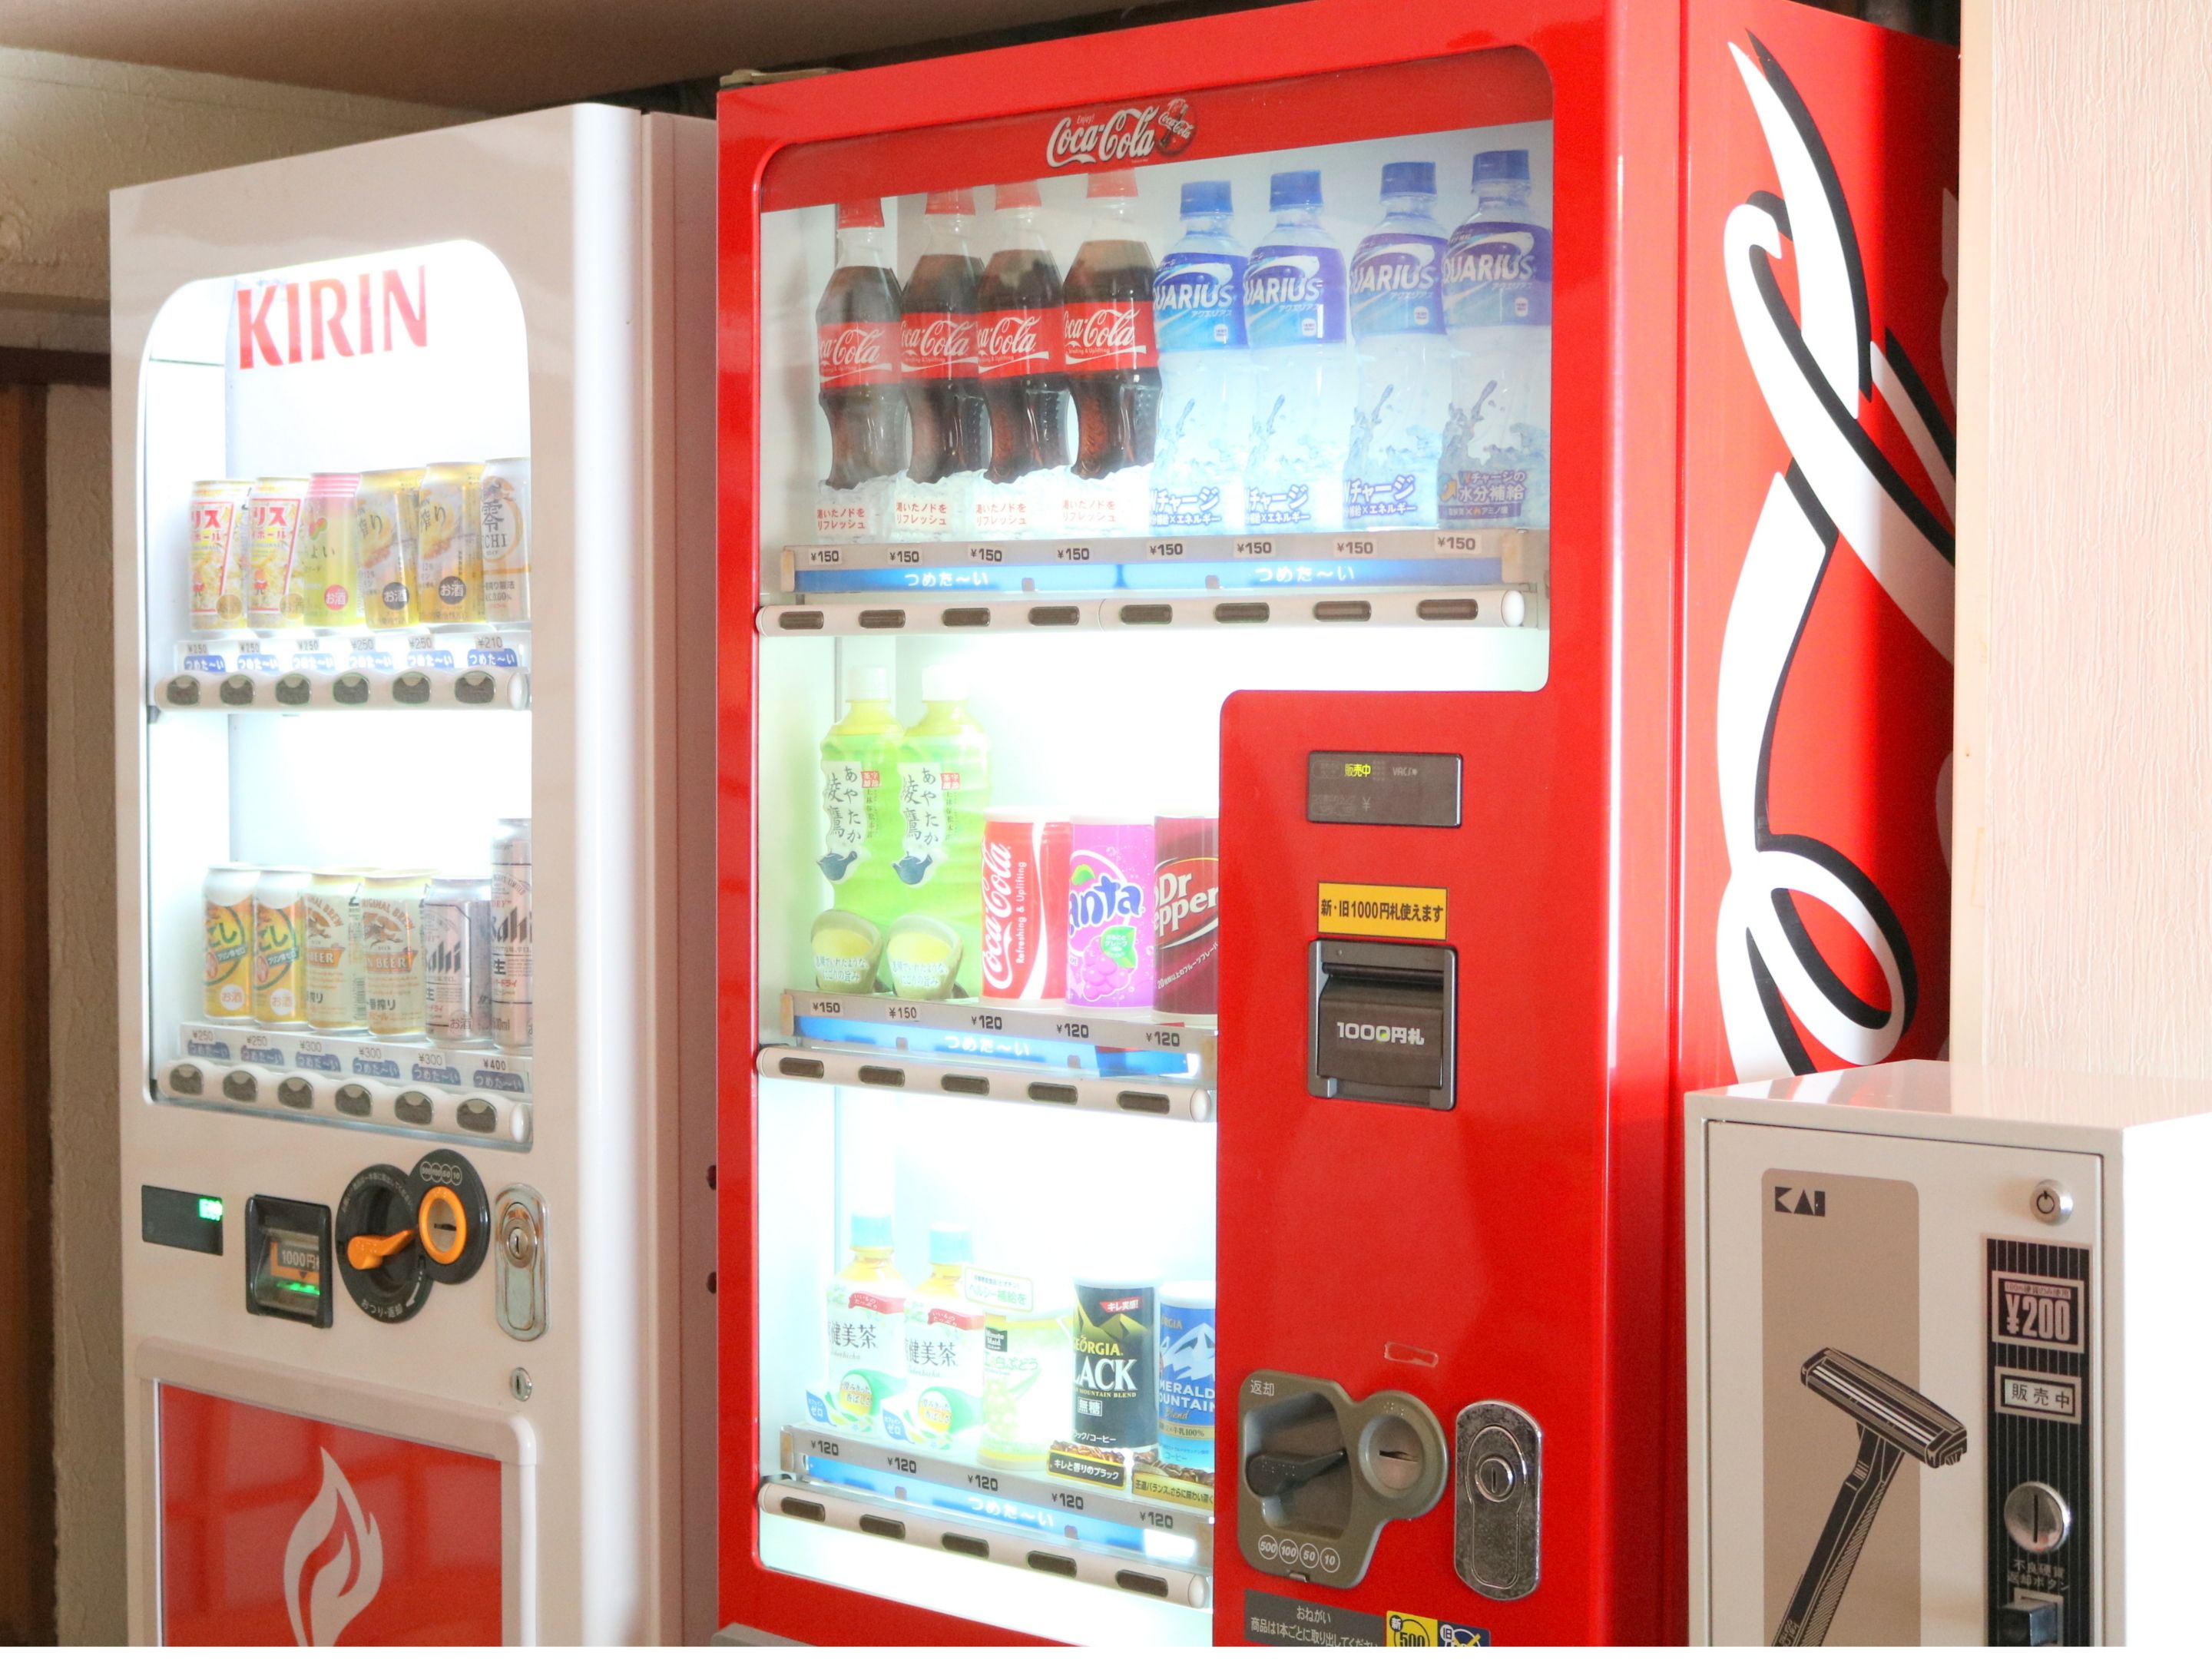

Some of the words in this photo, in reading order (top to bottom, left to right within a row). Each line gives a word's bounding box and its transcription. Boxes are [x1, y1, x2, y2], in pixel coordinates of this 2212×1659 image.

[1046, 105, 1161, 168] Coca-Cola
[237, 265, 428, 370] KIRIN
[1459, 484, 1525, 502] 水分補給
[817, 519, 865, 530] リフレッシュ
[896, 514, 946, 526] リフレッシュ
[976, 514, 1027, 526] リフレッシュ
[1063, 512, 1117, 523] リフレッシュ
[1150, 542, 1184, 556] ¥150
[1237, 541, 1272, 555] ¥150
[1337, 541, 1373, 555] ¥150
[1438, 535, 1476, 551] ¥150
[810, 549, 839, 562] ¥150
[889, 550, 919, 563] ¥150
[971, 548, 1002, 562] ¥150
[1058, 547, 1090, 561] ¥150
[905, 571, 989, 588] つめた～い
[1254, 565, 1355, 582] つめた～い
[325, 590, 346, 605] お酒
[384, 589, 407, 603] お酒
[440, 584, 464, 598] お酒
[187, 643, 207, 654] ¥250
[240, 641, 260, 653] ¥250
[298, 639, 320, 651] ¥250
[351, 638, 374, 651] ¥250
[409, 636, 432, 649] ¥250
[477, 636, 504, 648] ¥210
[469, 653, 516, 666] つめた～い
[844, 765, 862, 845] あやたか
[921, 767, 939, 846] あやたか
[1015, 861, 1028, 902] Uplifting
[1159, 872, 1193, 906] Dr
[1321, 898, 1444, 923] 新・旧1000円札使えます
[1016, 916, 1028, 964] Refreshing
[813, 1001, 840, 1015] ¥150
[889, 1005, 919, 1020] ¥150
[971, 1015, 1003, 1031] ¥120
[1056, 1022, 1090, 1038] ¥120
[193, 1030, 214, 1041] ¥250
[247, 1035, 267, 1047] ¥250
[1145, 1031, 1181, 1047] ¥120
[1336, 1022, 1426, 1046] 1000円札
[300, 1040, 322, 1052] ¥300
[359, 1047, 382, 1059] ¥300
[944, 1034, 1031, 1056] つめた～い
[418, 1052, 442, 1066] ¥300
[483, 1058, 506, 1071] ¥400
[2005, 1293, 2071, 1342] ¥200
[828, 1320, 878, 1349] 健美茶
[905, 1338, 959, 1368] 健美茶
[1075, 1355, 1138, 1392] ACK
[1250, 1379, 1276, 1397] 返却
[2011, 1382, 2071, 1410] 販売中
[1078, 1398, 1101, 1416] 無糖
[811, 1440, 839, 1457] ¥120
[887, 1456, 918, 1475] ¥120
[1053, 1458, 1120, 1481] キレと香りのブラック
[968, 1474, 999, 1492] ¥120
[1051, 1492, 1085, 1511] ¥120
[968, 1495, 1055, 1528] つめた～い
[1140, 1511, 1174, 1530] ¥120
[1259, 1540, 1278, 1555] 500
[1280, 1544, 1298, 1558] 100
[1303, 1549, 1316, 1562] 50
[1324, 1554, 1336, 1567] 10
[1296, 1604, 1331, 1624] おねがい
[1391, 1616, 1402, 1630] 新
[1442, 1626, 1452, 1641] 旧
